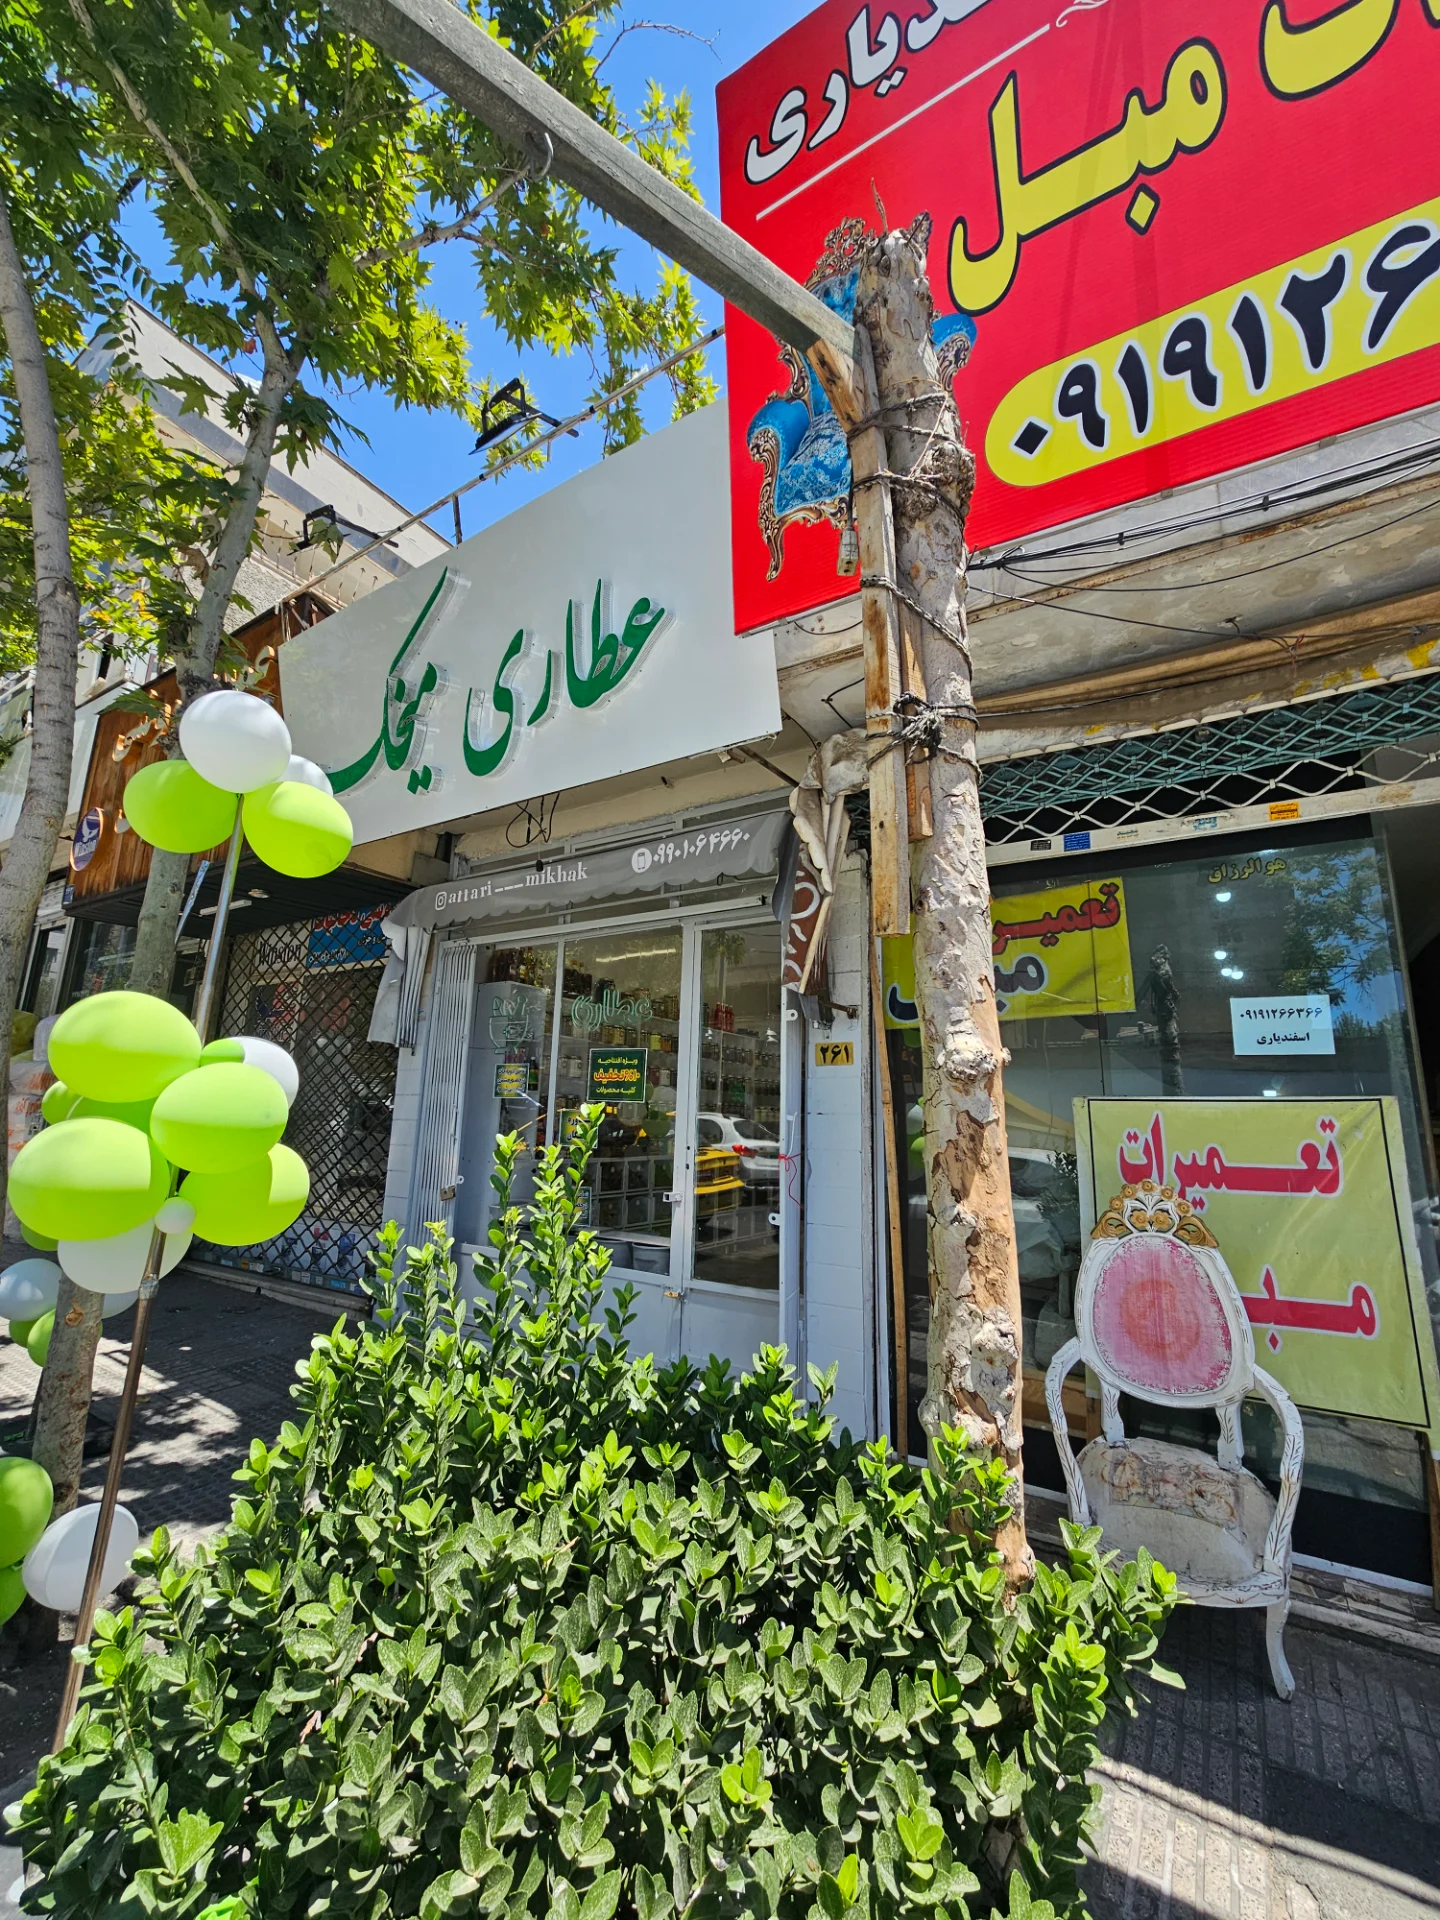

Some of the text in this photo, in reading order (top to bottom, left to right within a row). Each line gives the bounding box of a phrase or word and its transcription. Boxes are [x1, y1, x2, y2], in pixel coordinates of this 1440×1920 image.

[744, 0, 996, 185] دیاری
[947, 36, 1228, 316] مبل
[327, 565, 672, 796] عطاری میخک
[653, 828, 750, 864] ۰۹۹۰۱۰۶۴۶۶۰
[1208, 856, 1287, 883] هو الرزاق
[992, 882, 1121, 955] تعمیر
[571, 989, 653, 1031] عطاری
[1240, 1007, 1323, 1020] ۰۹۱۹۱۲۶۶۳۶۶
[1256, 1032, 1310, 1045] اسفندیاری
[820, 1044, 849, 1064] ۲۶۱
[1118, 1111, 1343, 1212] تعمیرات
[1240, 1265, 1380, 1353] مب
